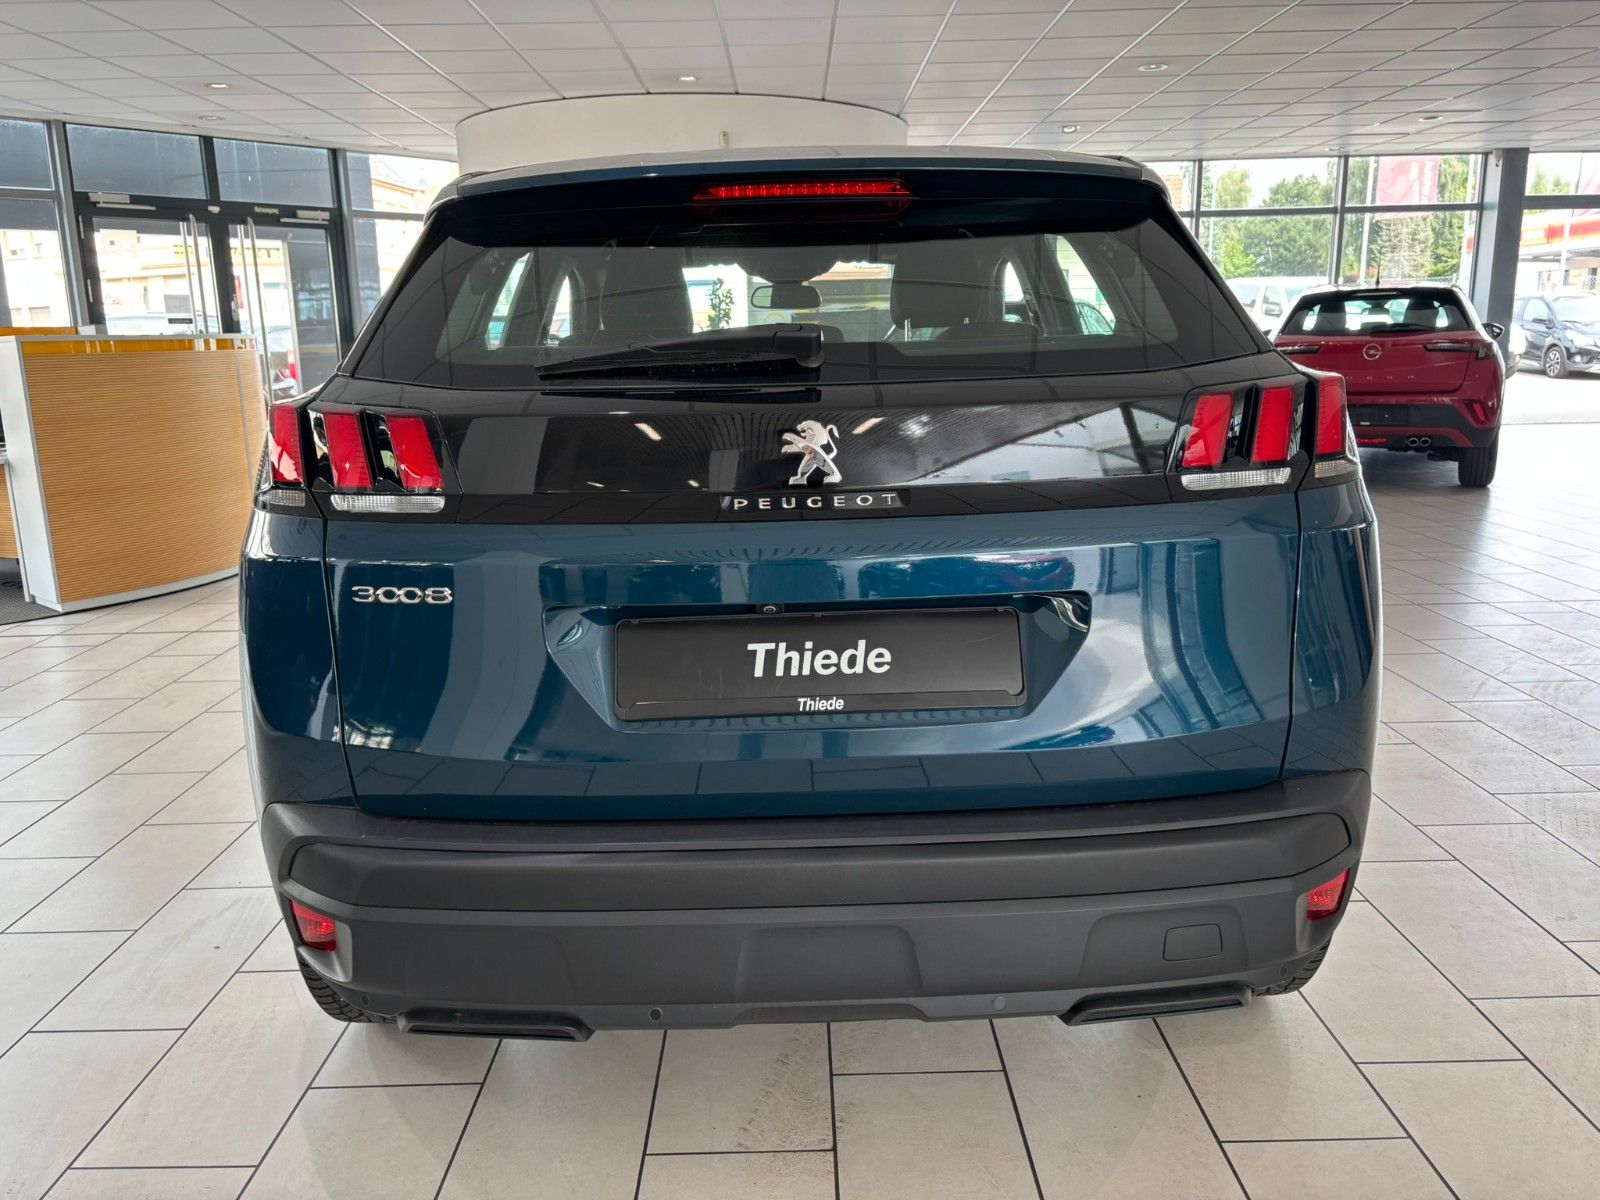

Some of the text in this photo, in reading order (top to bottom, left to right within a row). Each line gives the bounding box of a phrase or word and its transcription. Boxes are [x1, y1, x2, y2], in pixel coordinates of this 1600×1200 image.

[733, 493, 897, 510] PEUGEOT
[351, 585, 453, 604] 3008
[747, 639, 892, 678] Thiede
[797, 697, 845, 712] Thiede
